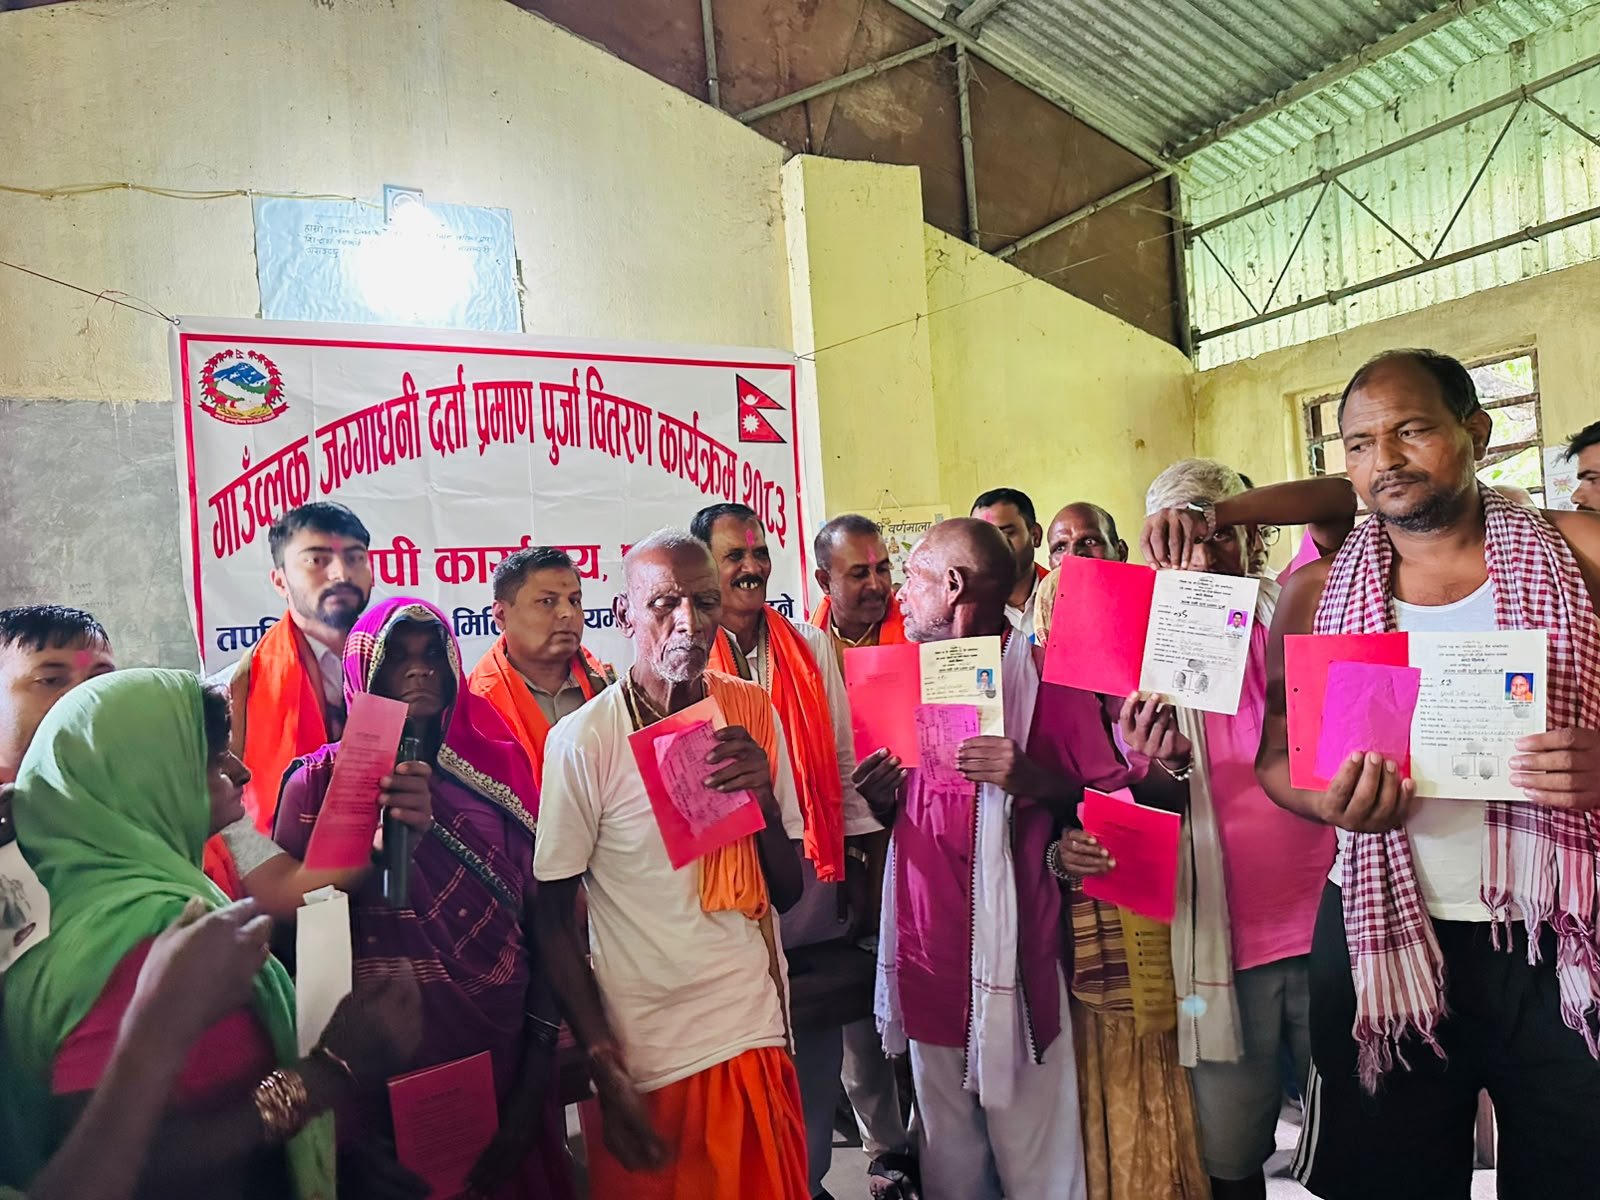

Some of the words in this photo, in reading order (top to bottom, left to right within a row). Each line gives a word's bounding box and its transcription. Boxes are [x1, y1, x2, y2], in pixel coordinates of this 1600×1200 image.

[315, 372, 421, 494] जग्गाधनी
[426, 364, 468, 458] दर्ता
[472, 381, 534, 456] प्रमाण
[586, 366, 652, 465] वितरण
[658, 411, 738, 504] कार्यक्रम
